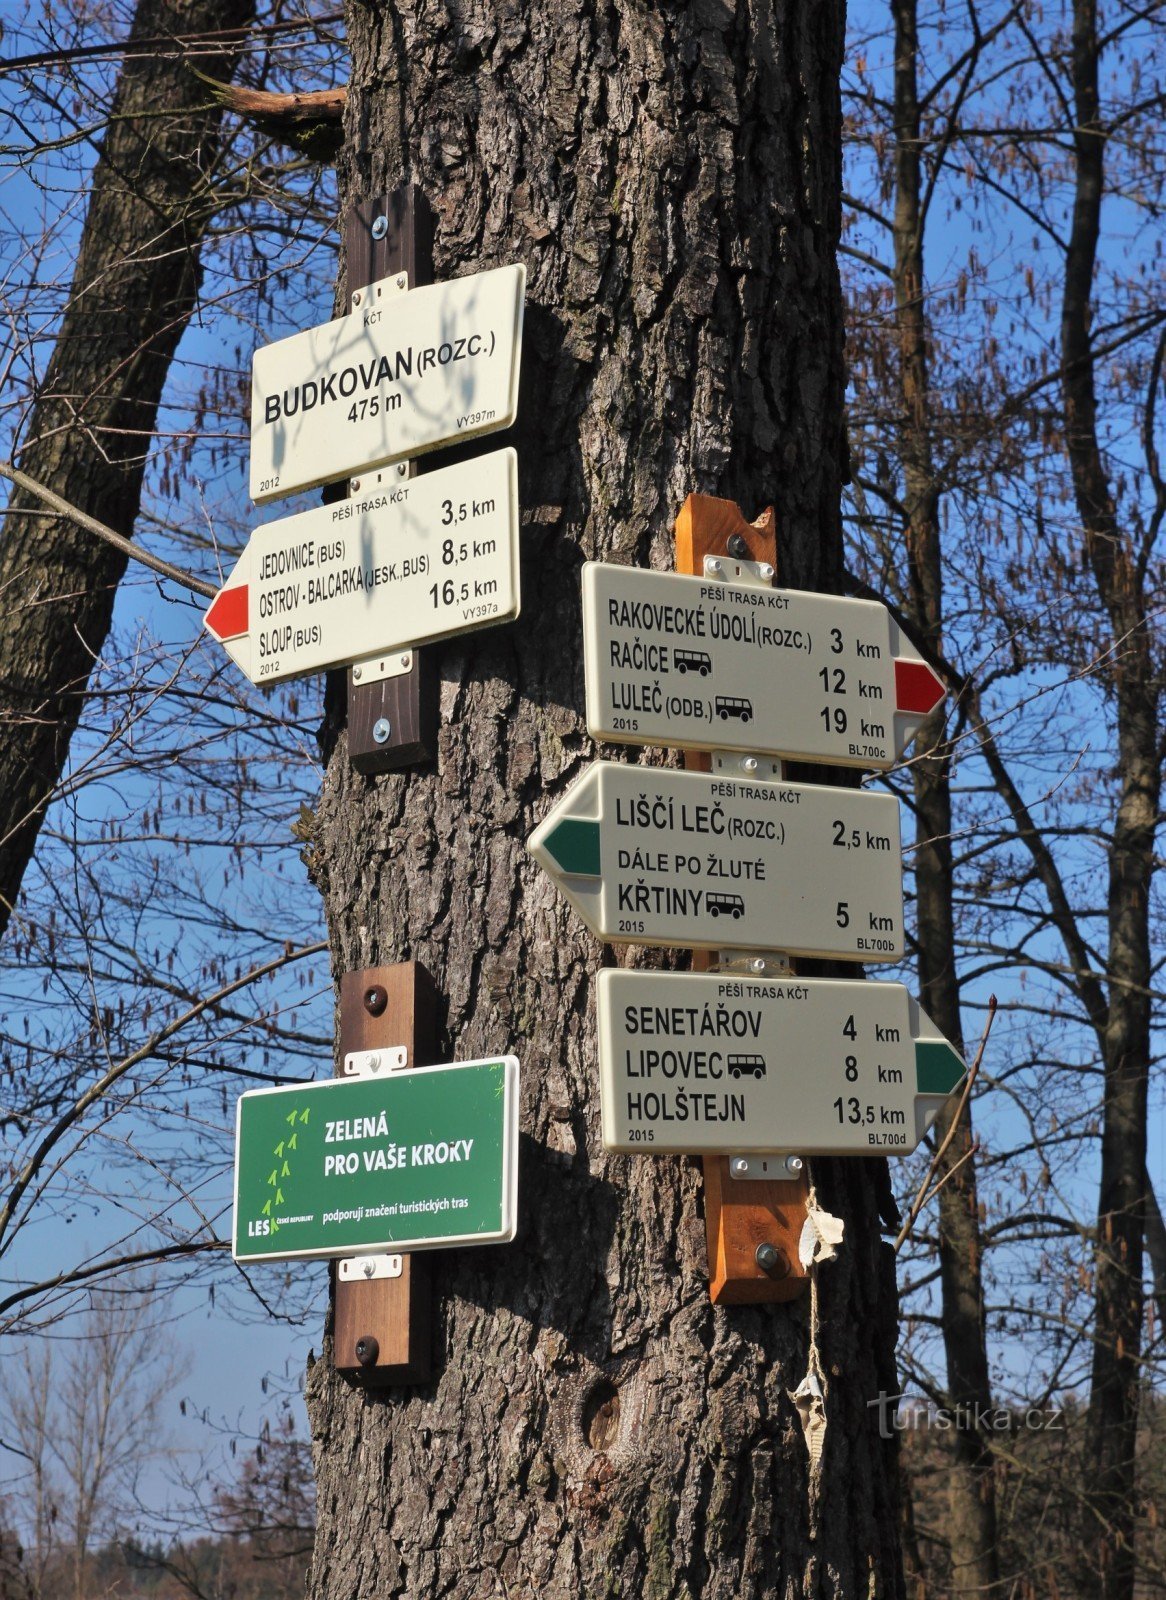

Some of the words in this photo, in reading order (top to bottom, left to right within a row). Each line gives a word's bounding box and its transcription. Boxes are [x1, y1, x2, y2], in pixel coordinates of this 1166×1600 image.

[363, 311, 382, 328] KČT
[347, 398, 379, 423] 475
[385, 392, 402, 412] m
[456, 409, 496, 429] VY397m
[260, 476, 280, 492] 2012
[332, 506, 354, 522] PĚŠÍ
[355, 497, 388, 515] TRASA
[389, 488, 409, 506] KČT
[441, 500, 467, 527] 3,5
[472, 498, 495, 518] km
[441, 539, 468, 566] 8,5
[473, 539, 496, 559] km
[259, 584, 300, 619] OSTROV
[429, 579, 469, 609] 16,5
[474, 578, 497, 599] km
[700, 588, 726, 602] PĚŠÍ
[728, 591, 765, 607] TRASA
[768, 594, 789, 610] KČT
[462, 604, 498, 620] VY397a
[609, 599, 705, 637] RAKOVECKÉ
[610, 636, 669, 673] RAČICE
[830, 628, 844, 654] 3
[856, 639, 881, 659] km
[260, 661, 280, 676] 2012
[819, 667, 847, 694] 12
[858, 680, 883, 699] km
[611, 680, 662, 714] LULEČ
[666, 696, 712, 723] (ODB.)
[612, 717, 638, 731] 2015
[820, 707, 848, 734] 19
[860, 719, 885, 738] km
[848, 743, 886, 758] BL700c
[711, 783, 736, 797] PĚŠÍ
[739, 787, 776, 801] TRASA
[778, 790, 801, 804] KČT
[616, 793, 674, 830] LIŠČÍ
[832, 821, 861, 851] 2,5
[866, 832, 891, 851] km
[618, 848, 669, 872] DÁLE
[674, 855, 701, 875] PO
[707, 853, 766, 881] ŽLUTÉ
[618, 878, 703, 917] KŘTINY
[618, 920, 645, 933] 2015
[836, 902, 850, 928] 5
[869, 912, 894, 932] km
[857, 937, 895, 952] BL700b
[718, 984, 744, 998] PĚŠÍ
[746, 986, 784, 999] TRASA
[786, 987, 809, 1000] KČT
[625, 1002, 763, 1038] SENETÁŘOV
[842, 1015, 857, 1041] 4
[875, 1024, 900, 1042] km
[626, 1050, 723, 1079] LIPOVEC
[844, 1055, 858, 1082] 8
[878, 1065, 902, 1083] km
[627, 1086, 745, 1122] HOLŠTEJN
[833, 1097, 875, 1127] 13,5
[880, 1106, 905, 1124] km
[324, 1110, 389, 1143] ZELENÁ
[628, 1129, 654, 1142] 2015
[868, 1133, 906, 1145] BL700d
[324, 1153, 360, 1177] PRO
[363, 1143, 406, 1173] VAŠE
[411, 1139, 474, 1167] KROKY
[322, 1206, 364, 1225] podporují
[365, 1205, 398, 1218] značení
[399, 1198, 450, 1214] turistických
[451, 1197, 468, 1208] tras
